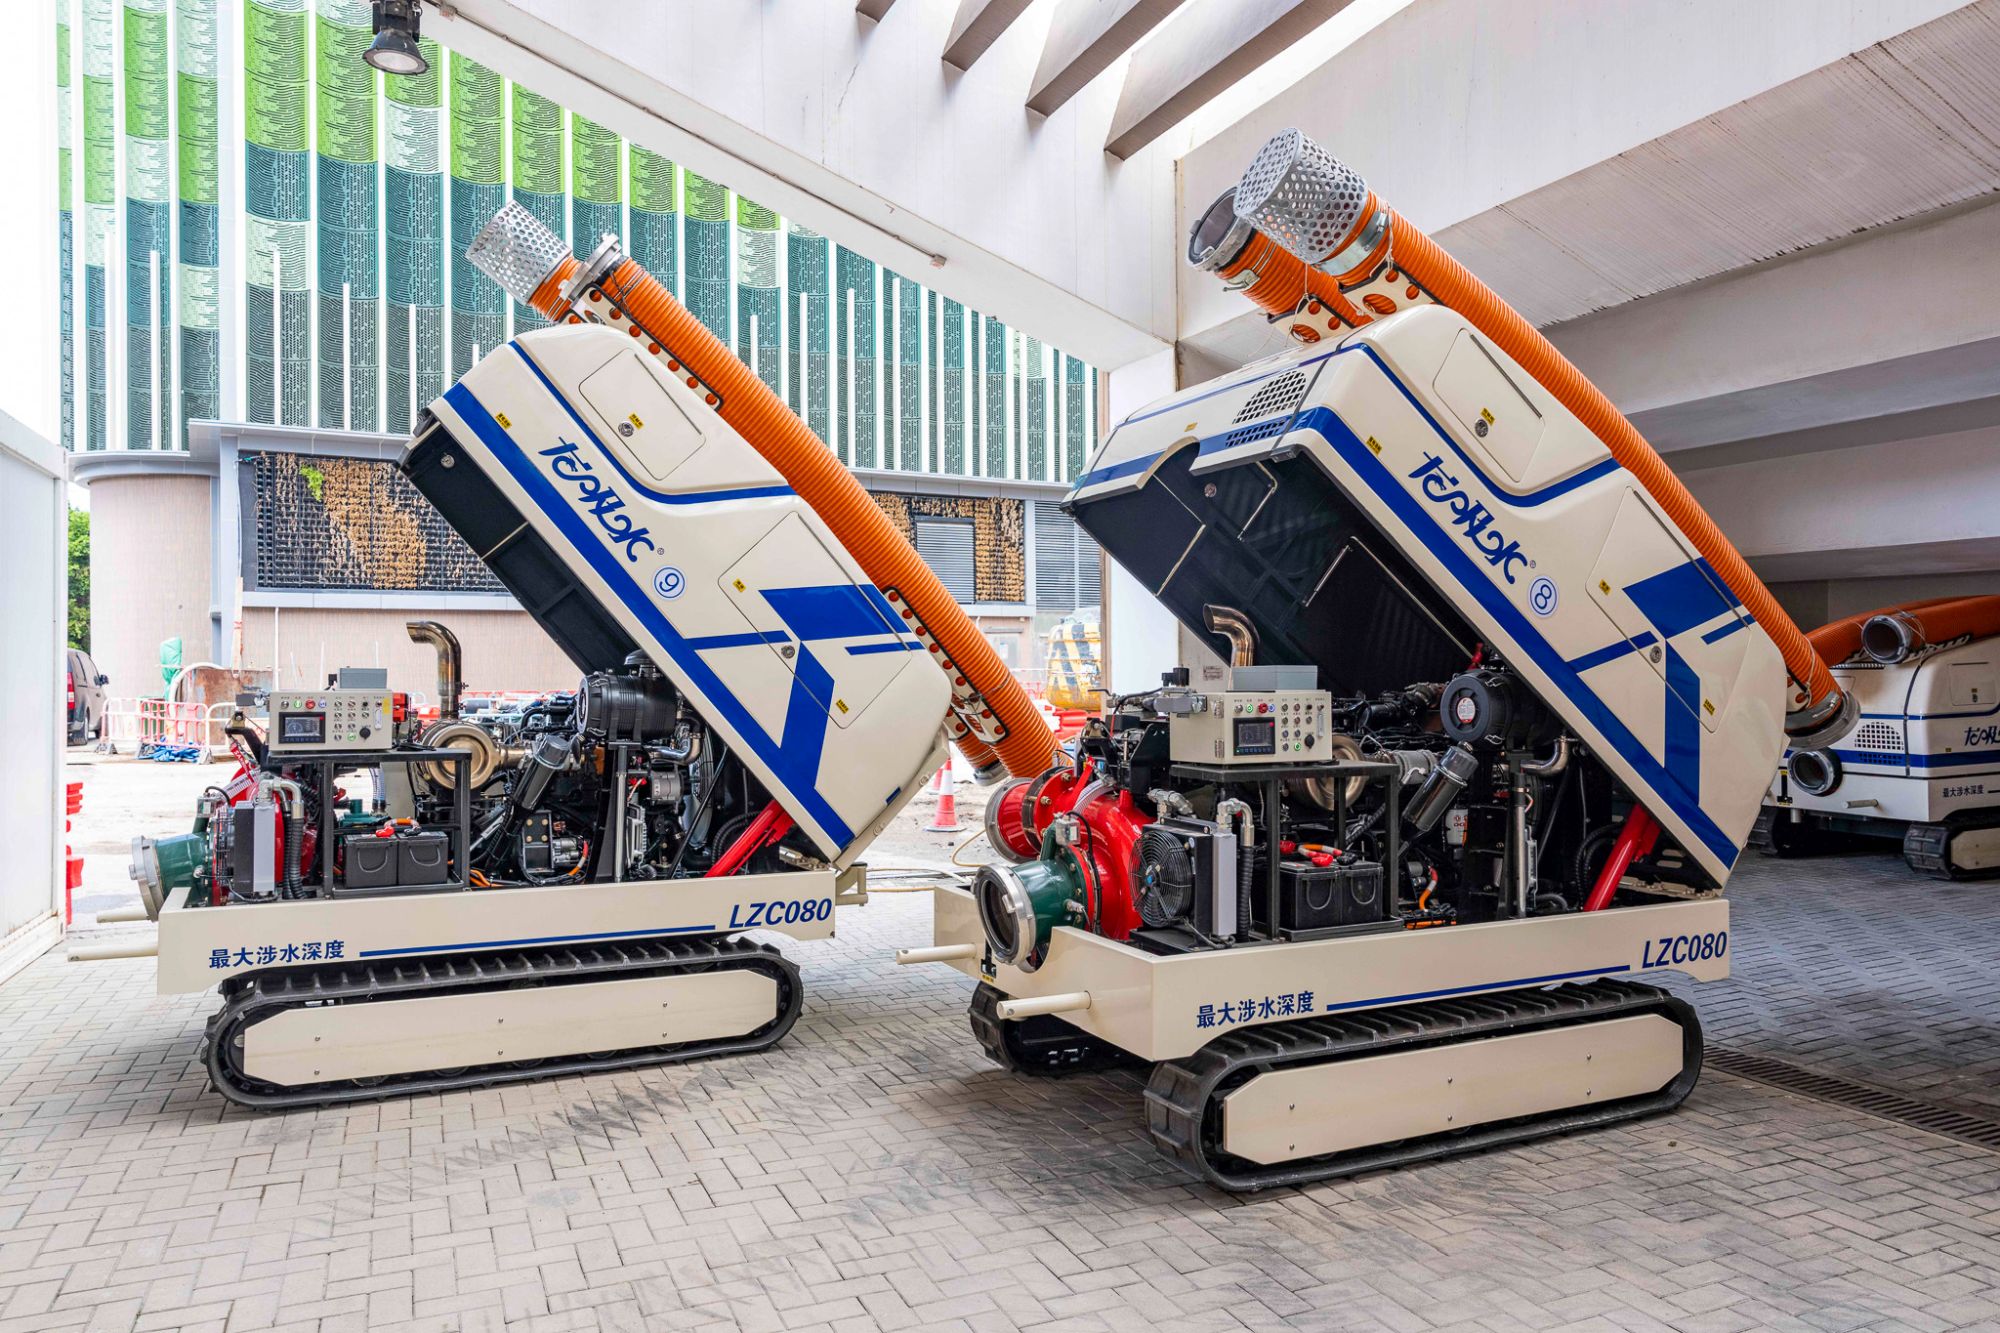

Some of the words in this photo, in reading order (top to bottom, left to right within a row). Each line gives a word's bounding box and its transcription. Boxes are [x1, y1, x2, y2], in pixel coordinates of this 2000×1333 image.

[1533, 582, 1554, 612] 8
[729, 898, 832, 929] LZC080
[208, 939, 345, 969] 最大涉水深度
[1642, 931, 1728, 968] LZC080
[1196, 990, 1314, 1029] 最大涉水深度
